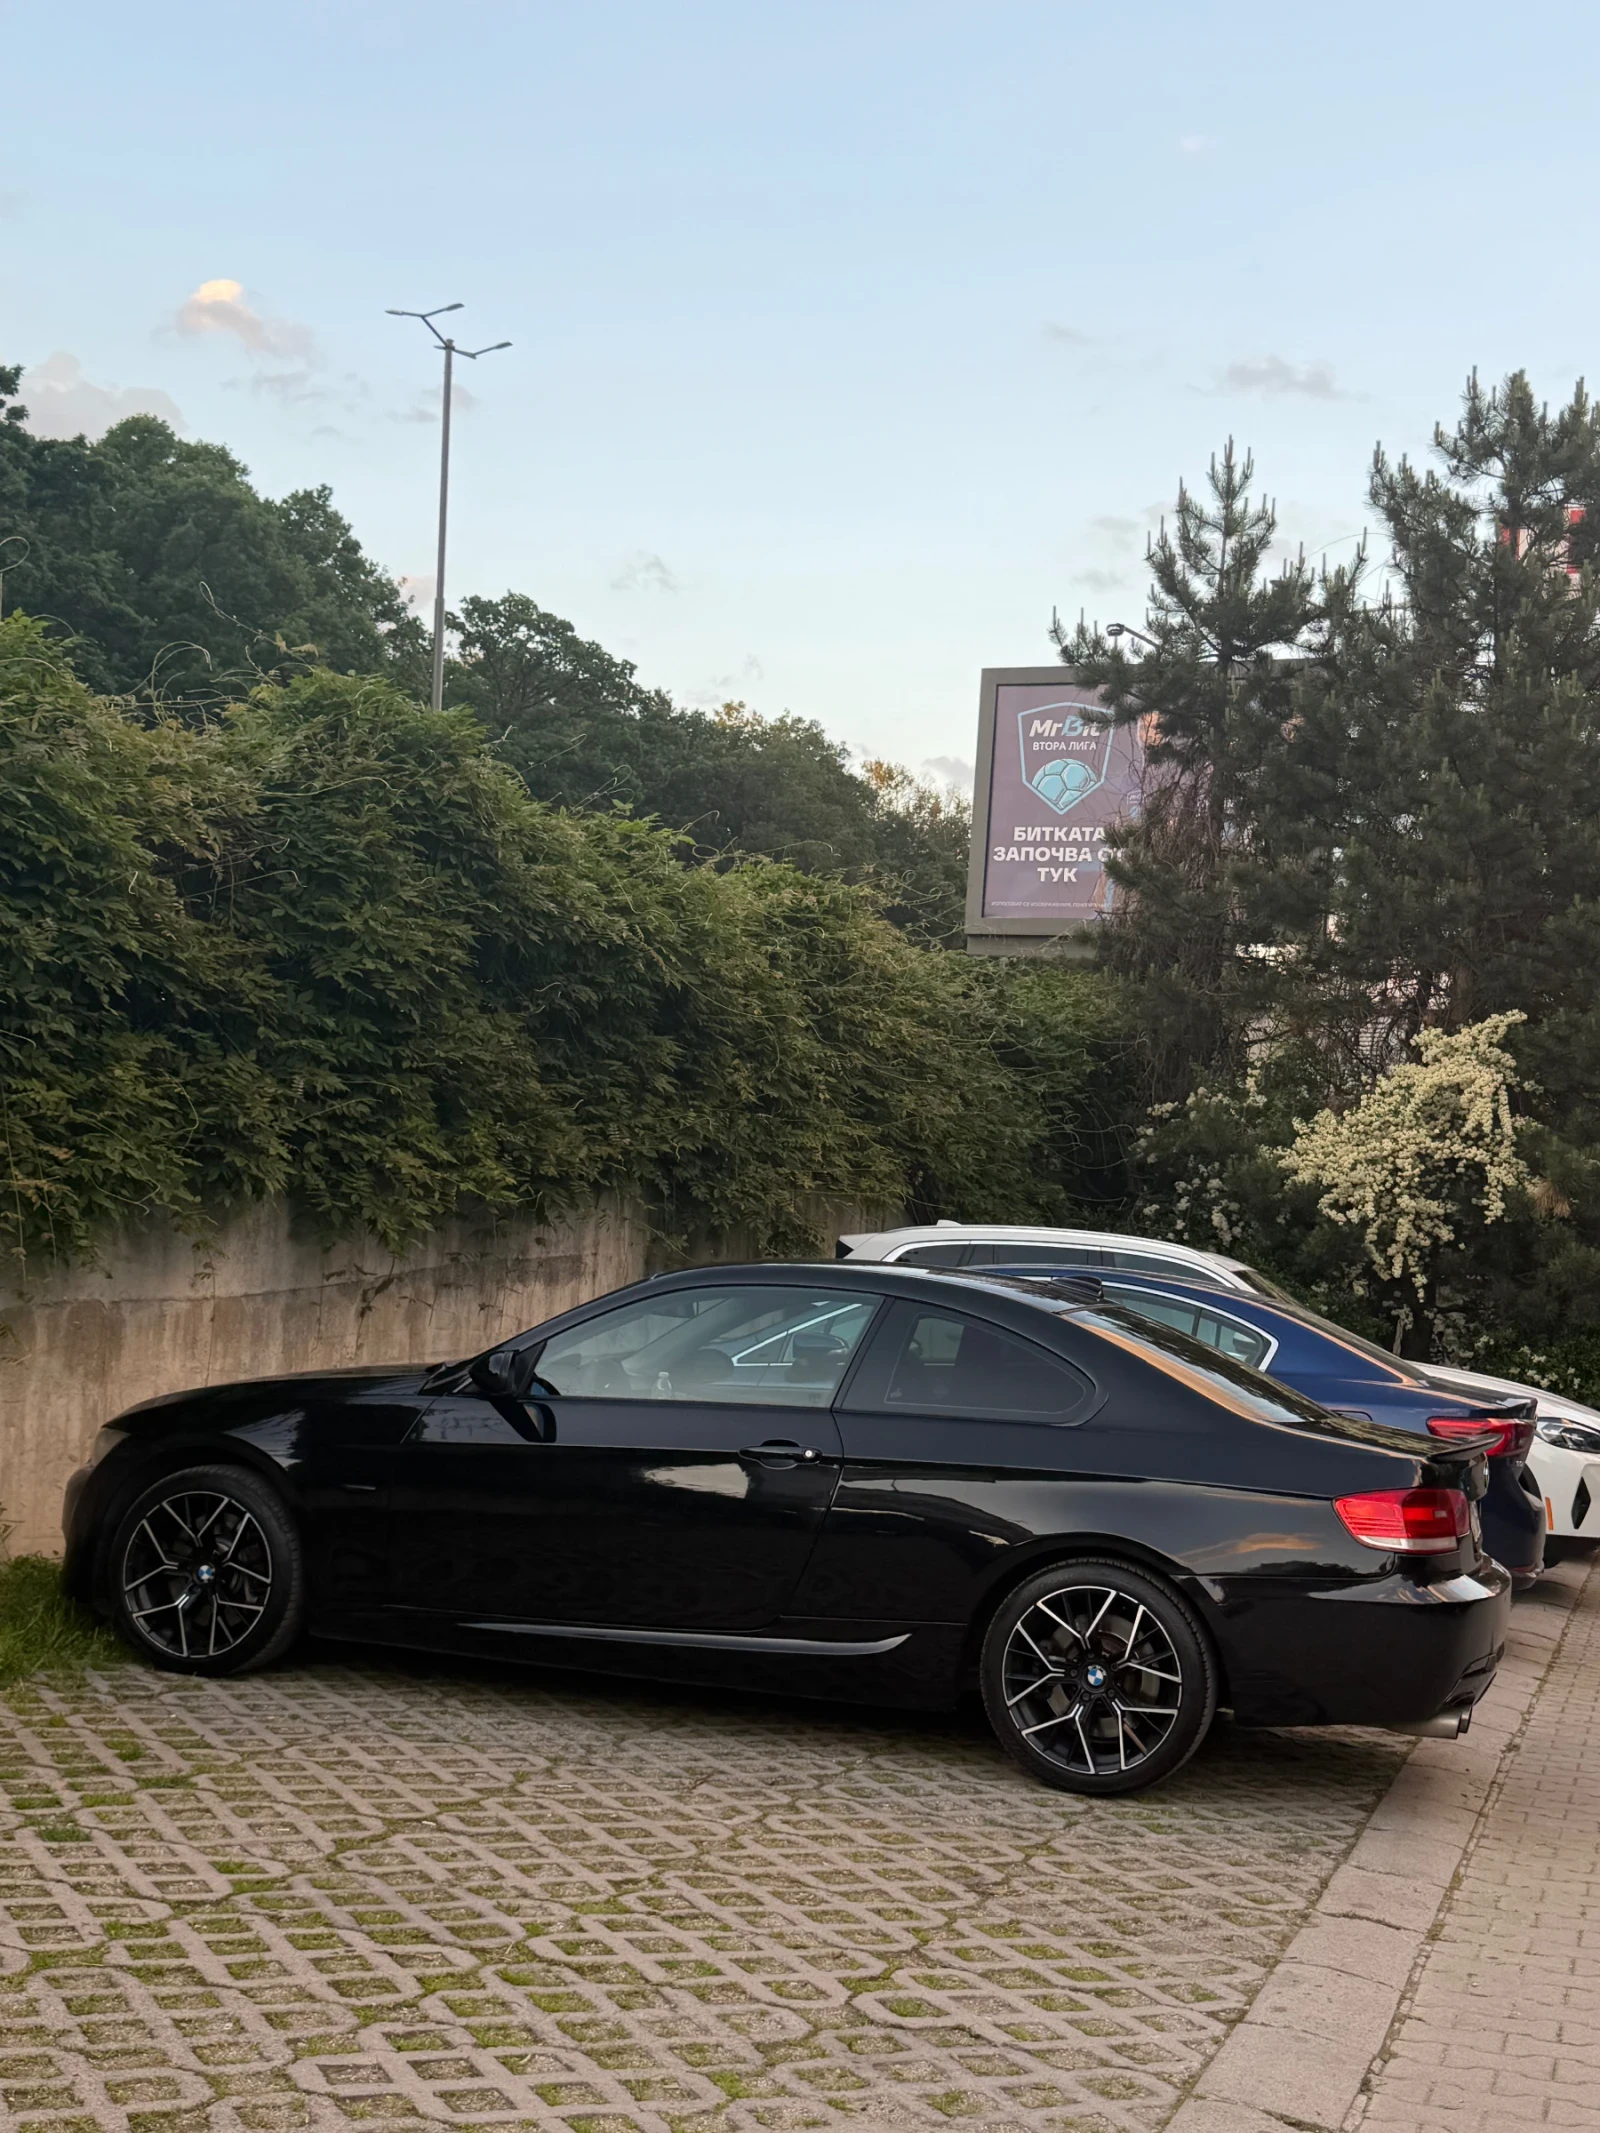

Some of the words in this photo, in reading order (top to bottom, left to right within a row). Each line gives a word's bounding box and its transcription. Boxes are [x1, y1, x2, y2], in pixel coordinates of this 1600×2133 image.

[1032, 741, 1066, 751] ВТОРА
[1068, 741, 1097, 751] ЛИГА
[1013, 826, 1106, 842] БИТКАТА
[992, 846, 1092, 862] ЗАПОЧВА
[1037, 867, 1078, 882] ТУК
